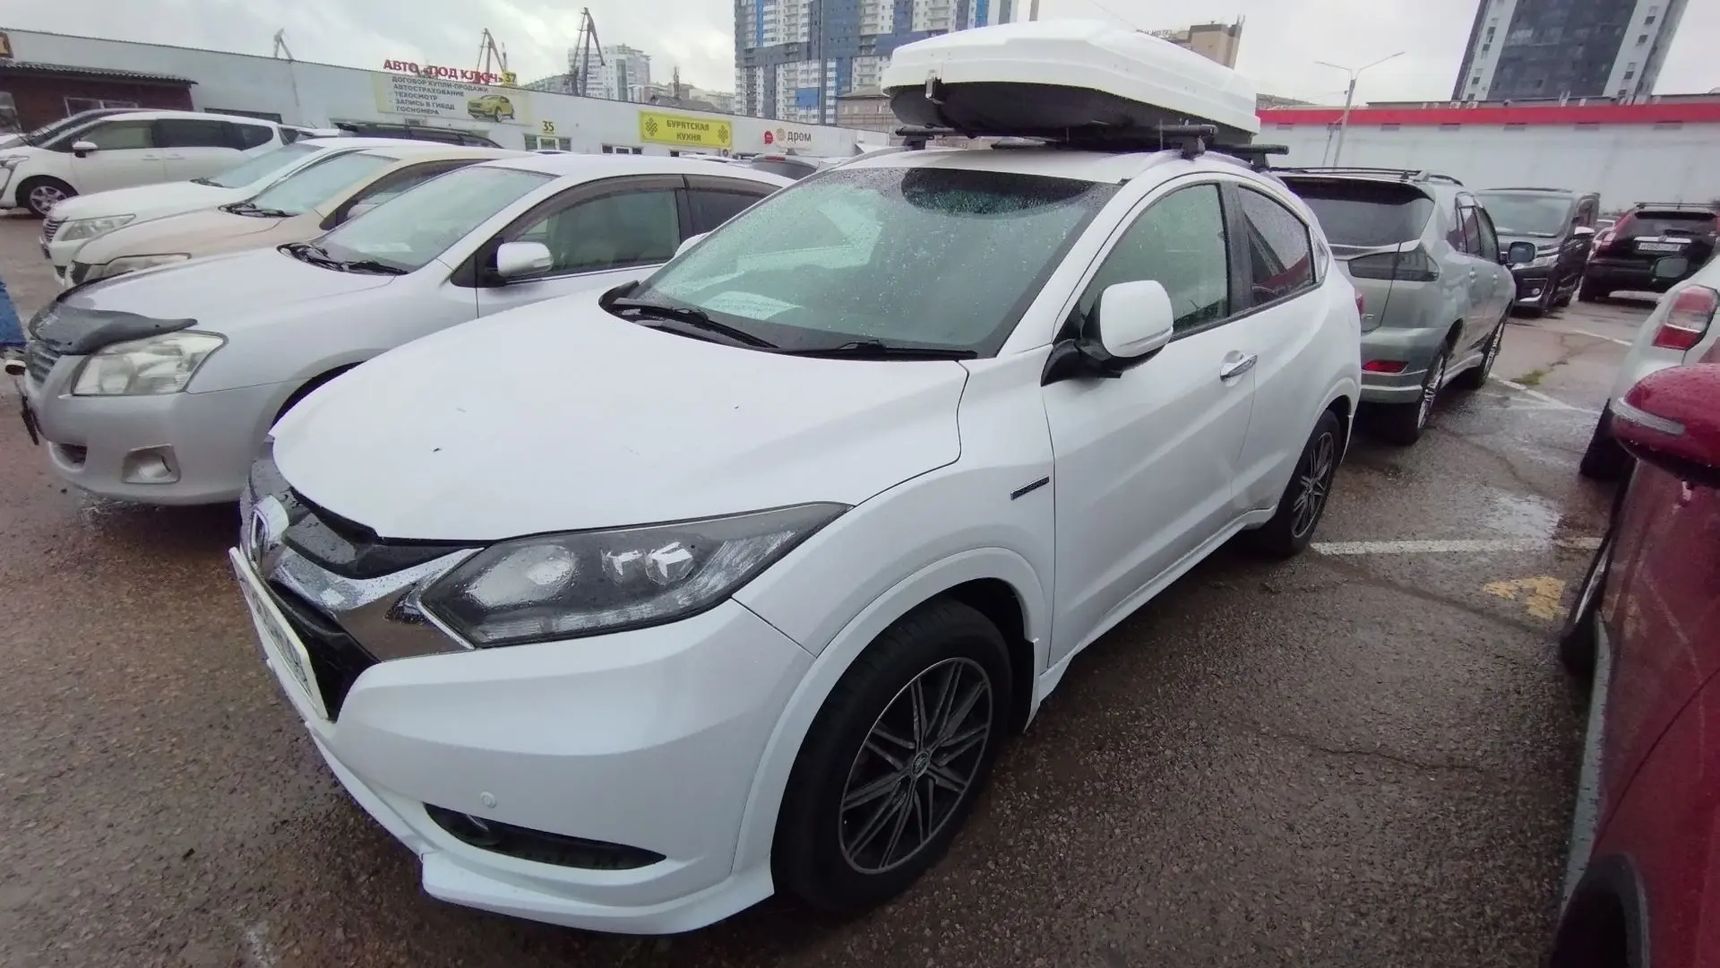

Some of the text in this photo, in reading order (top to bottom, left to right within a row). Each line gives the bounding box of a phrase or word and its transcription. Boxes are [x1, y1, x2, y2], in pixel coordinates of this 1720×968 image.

[383, 59, 419, 73] АВТО
[505, 72, 517, 82] 37
[392, 76, 488, 92] ДОГОВОР КУПЛИ-ПРОДАЖИ
[393, 84, 464, 97] АВТОСТРАХОВАНИЕ
[395, 91, 438, 100] ТЕХОСМОТР
[396, 99, 425, 107] ЗАПИСЬ
[432, 102, 455, 110] ГИБДД
[396, 106, 439, 115] ГОСНОМЕРА
[542, 121, 554, 132] 35
[666, 119, 710, 132] БУРЯТСКАЯ
[676, 133, 701, 142] КУХНЯ
[787, 131, 812, 143] дром
